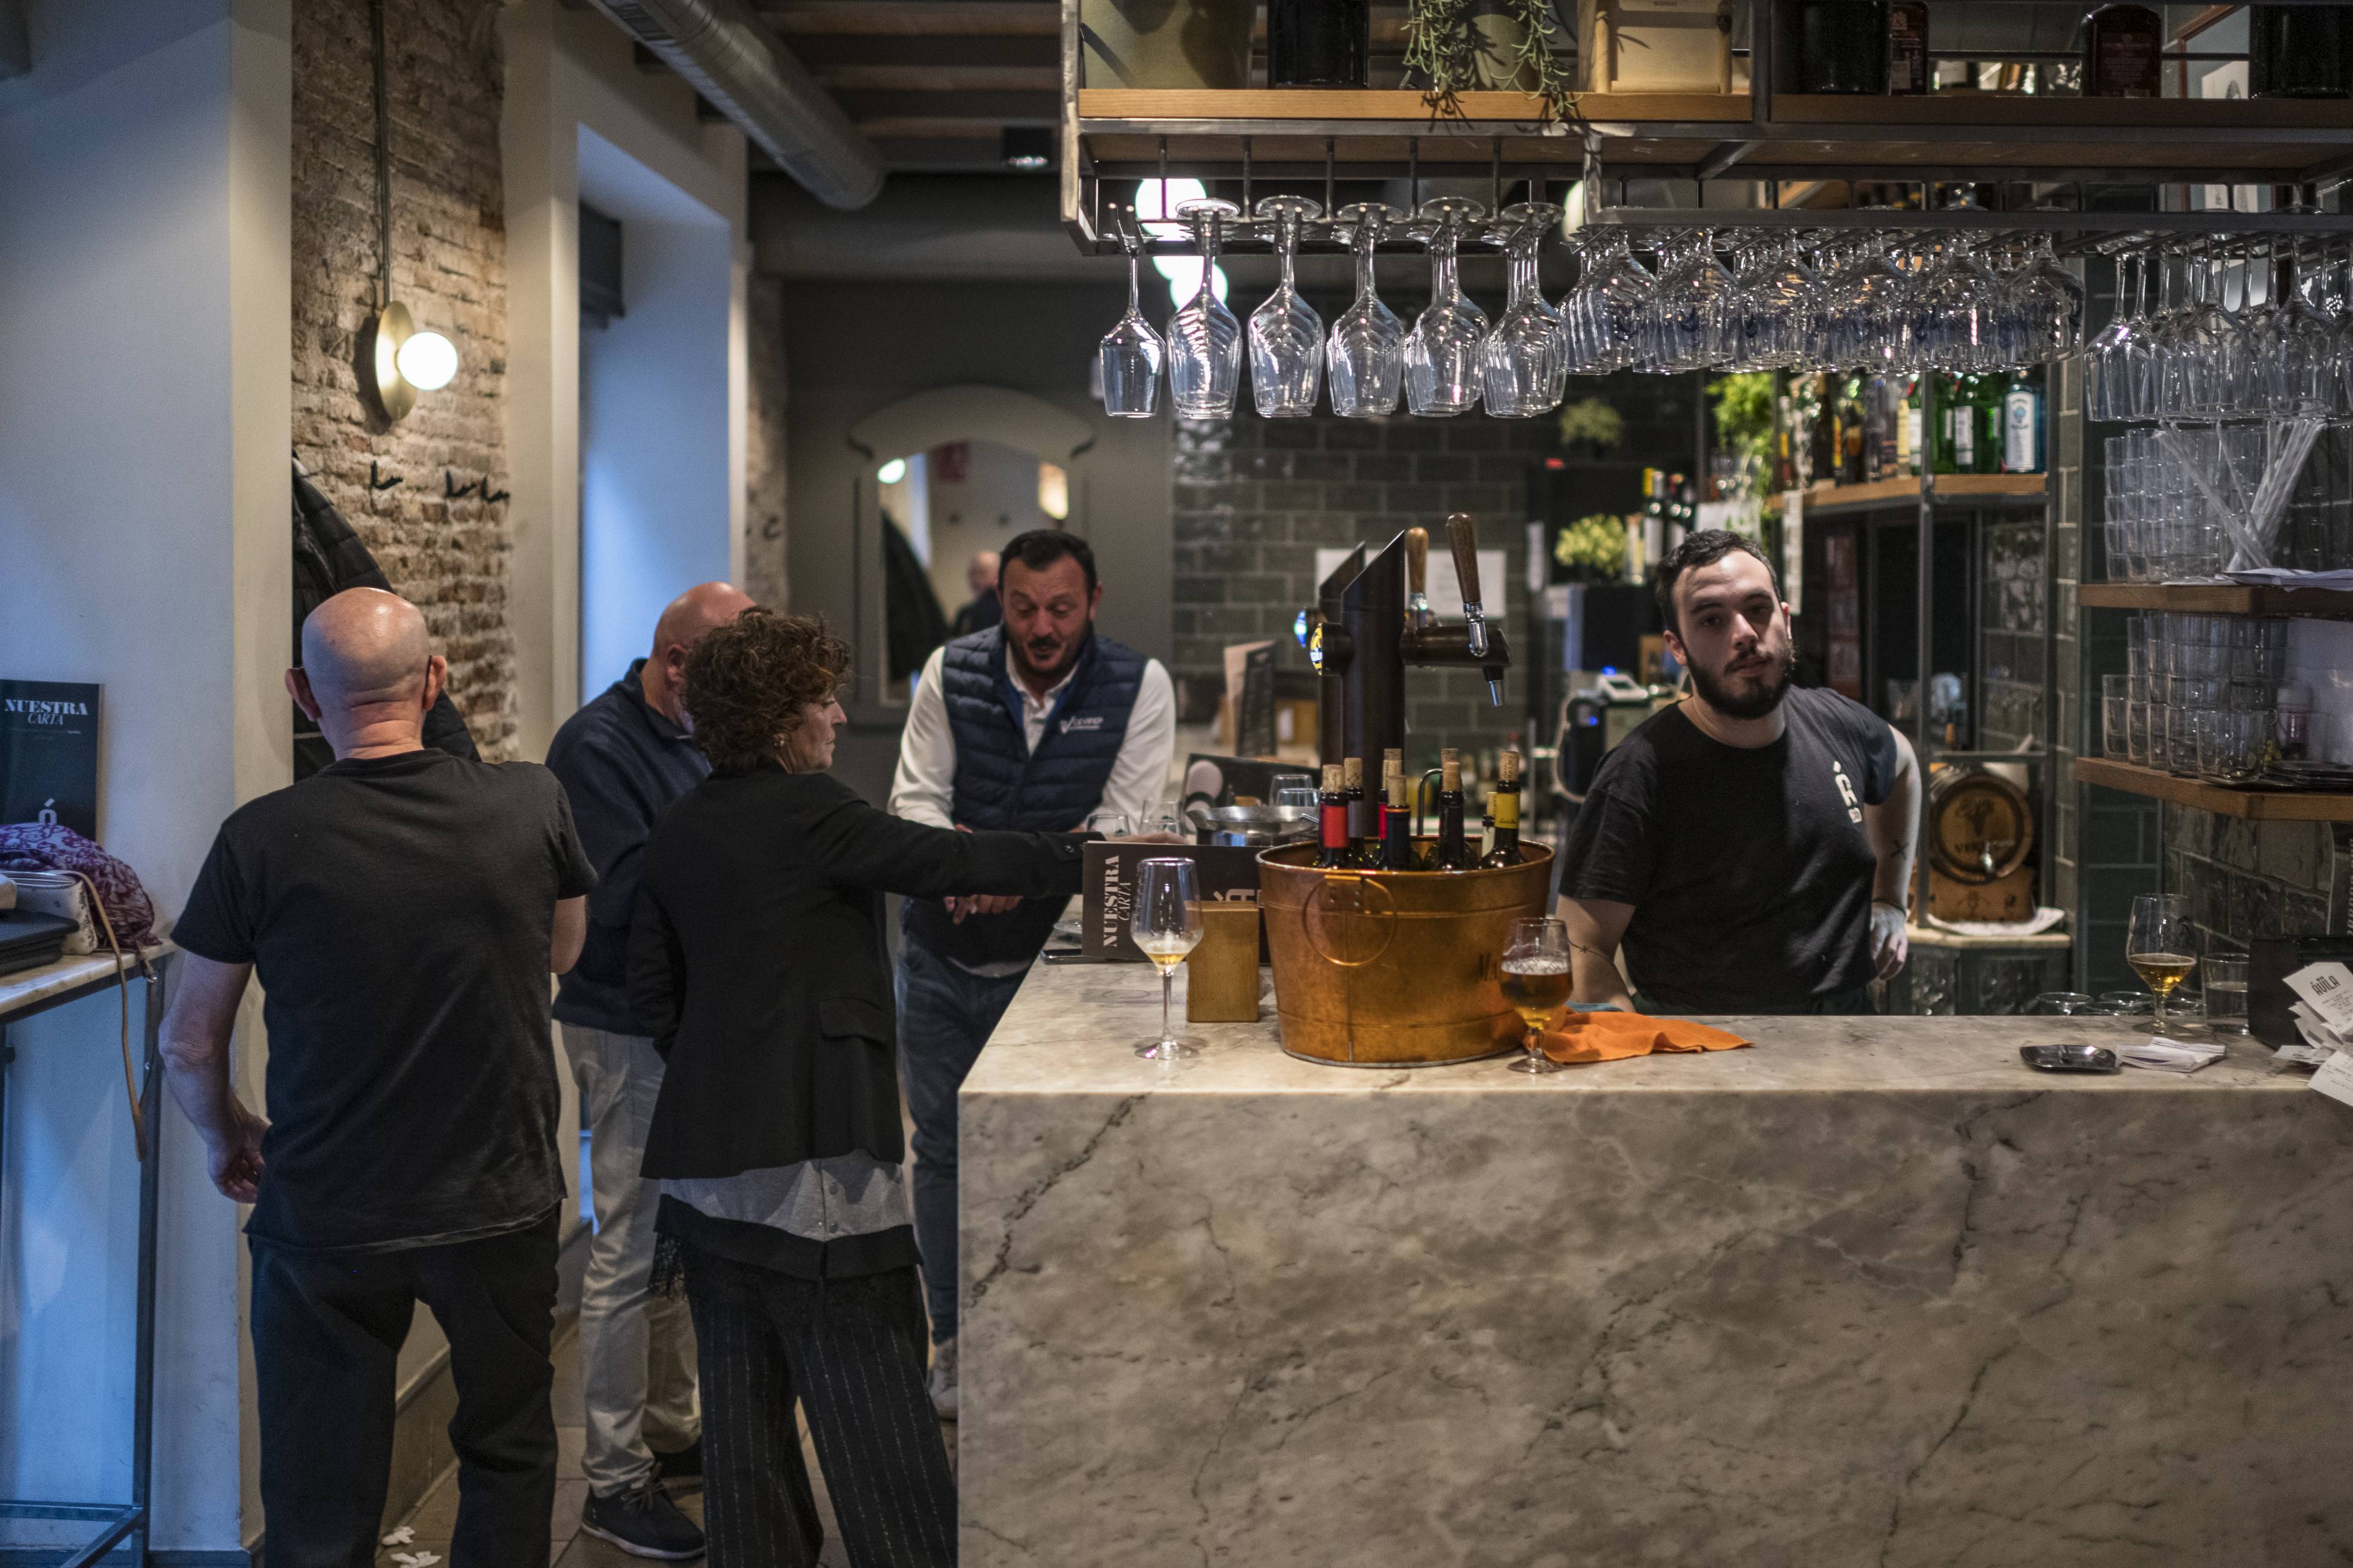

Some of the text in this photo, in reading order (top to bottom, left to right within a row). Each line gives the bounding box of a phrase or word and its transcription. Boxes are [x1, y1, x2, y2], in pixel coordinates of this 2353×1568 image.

[4, 698, 88, 716] NUESTRA
[28, 712, 64, 725] CARTA
[1102, 855, 1120, 948] NUESTRA
[1117, 882, 1132, 921] CARTA
[2310, 976, 2342, 996] ÁVILA
